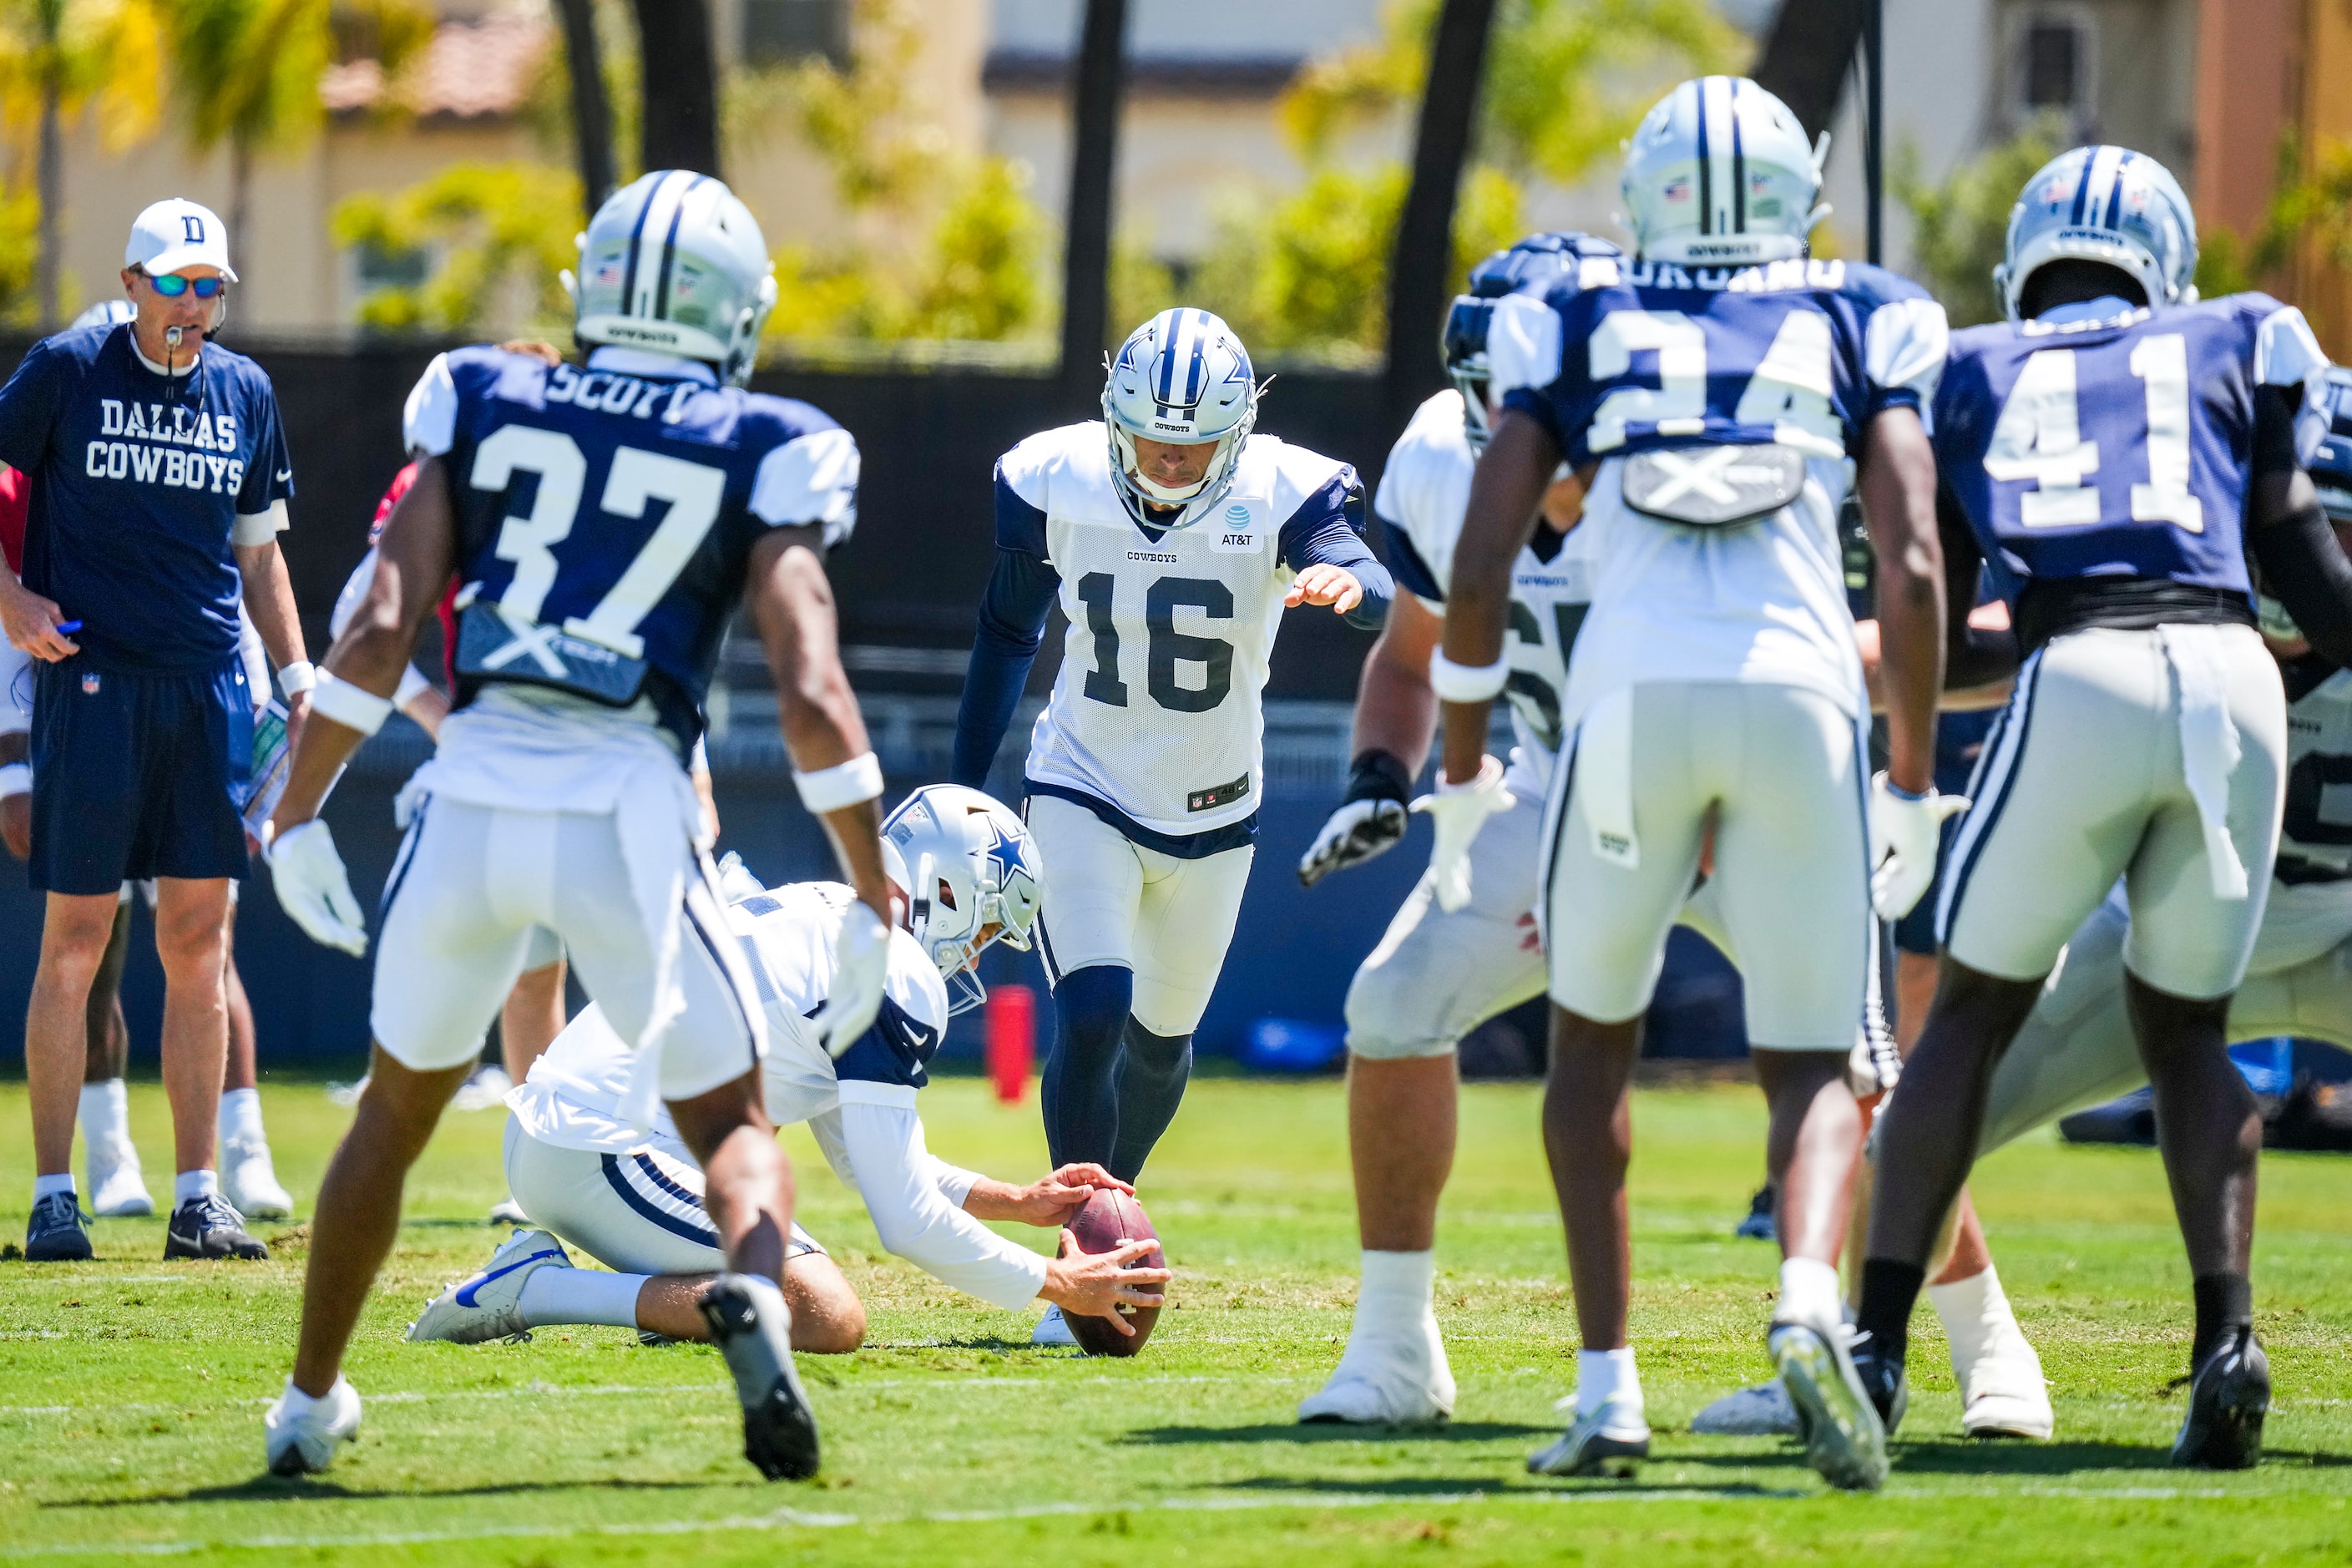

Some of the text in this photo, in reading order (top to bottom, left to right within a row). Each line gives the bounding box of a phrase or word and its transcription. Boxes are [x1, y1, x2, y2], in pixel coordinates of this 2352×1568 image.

[181, 215, 205, 244] D
[1587, 310, 1845, 459] 24
[101, 398, 237, 453] DALLAS
[1155, 422, 1190, 432] COWBOYS
[1982, 333, 2203, 534] 41
[86, 440, 245, 497] COWBOYS
[469, 423, 726, 660] 37
[1127, 551, 1177, 563] COWBOYS
[1222, 534, 1253, 546] AT&T
[1078, 571, 1234, 713] 16
